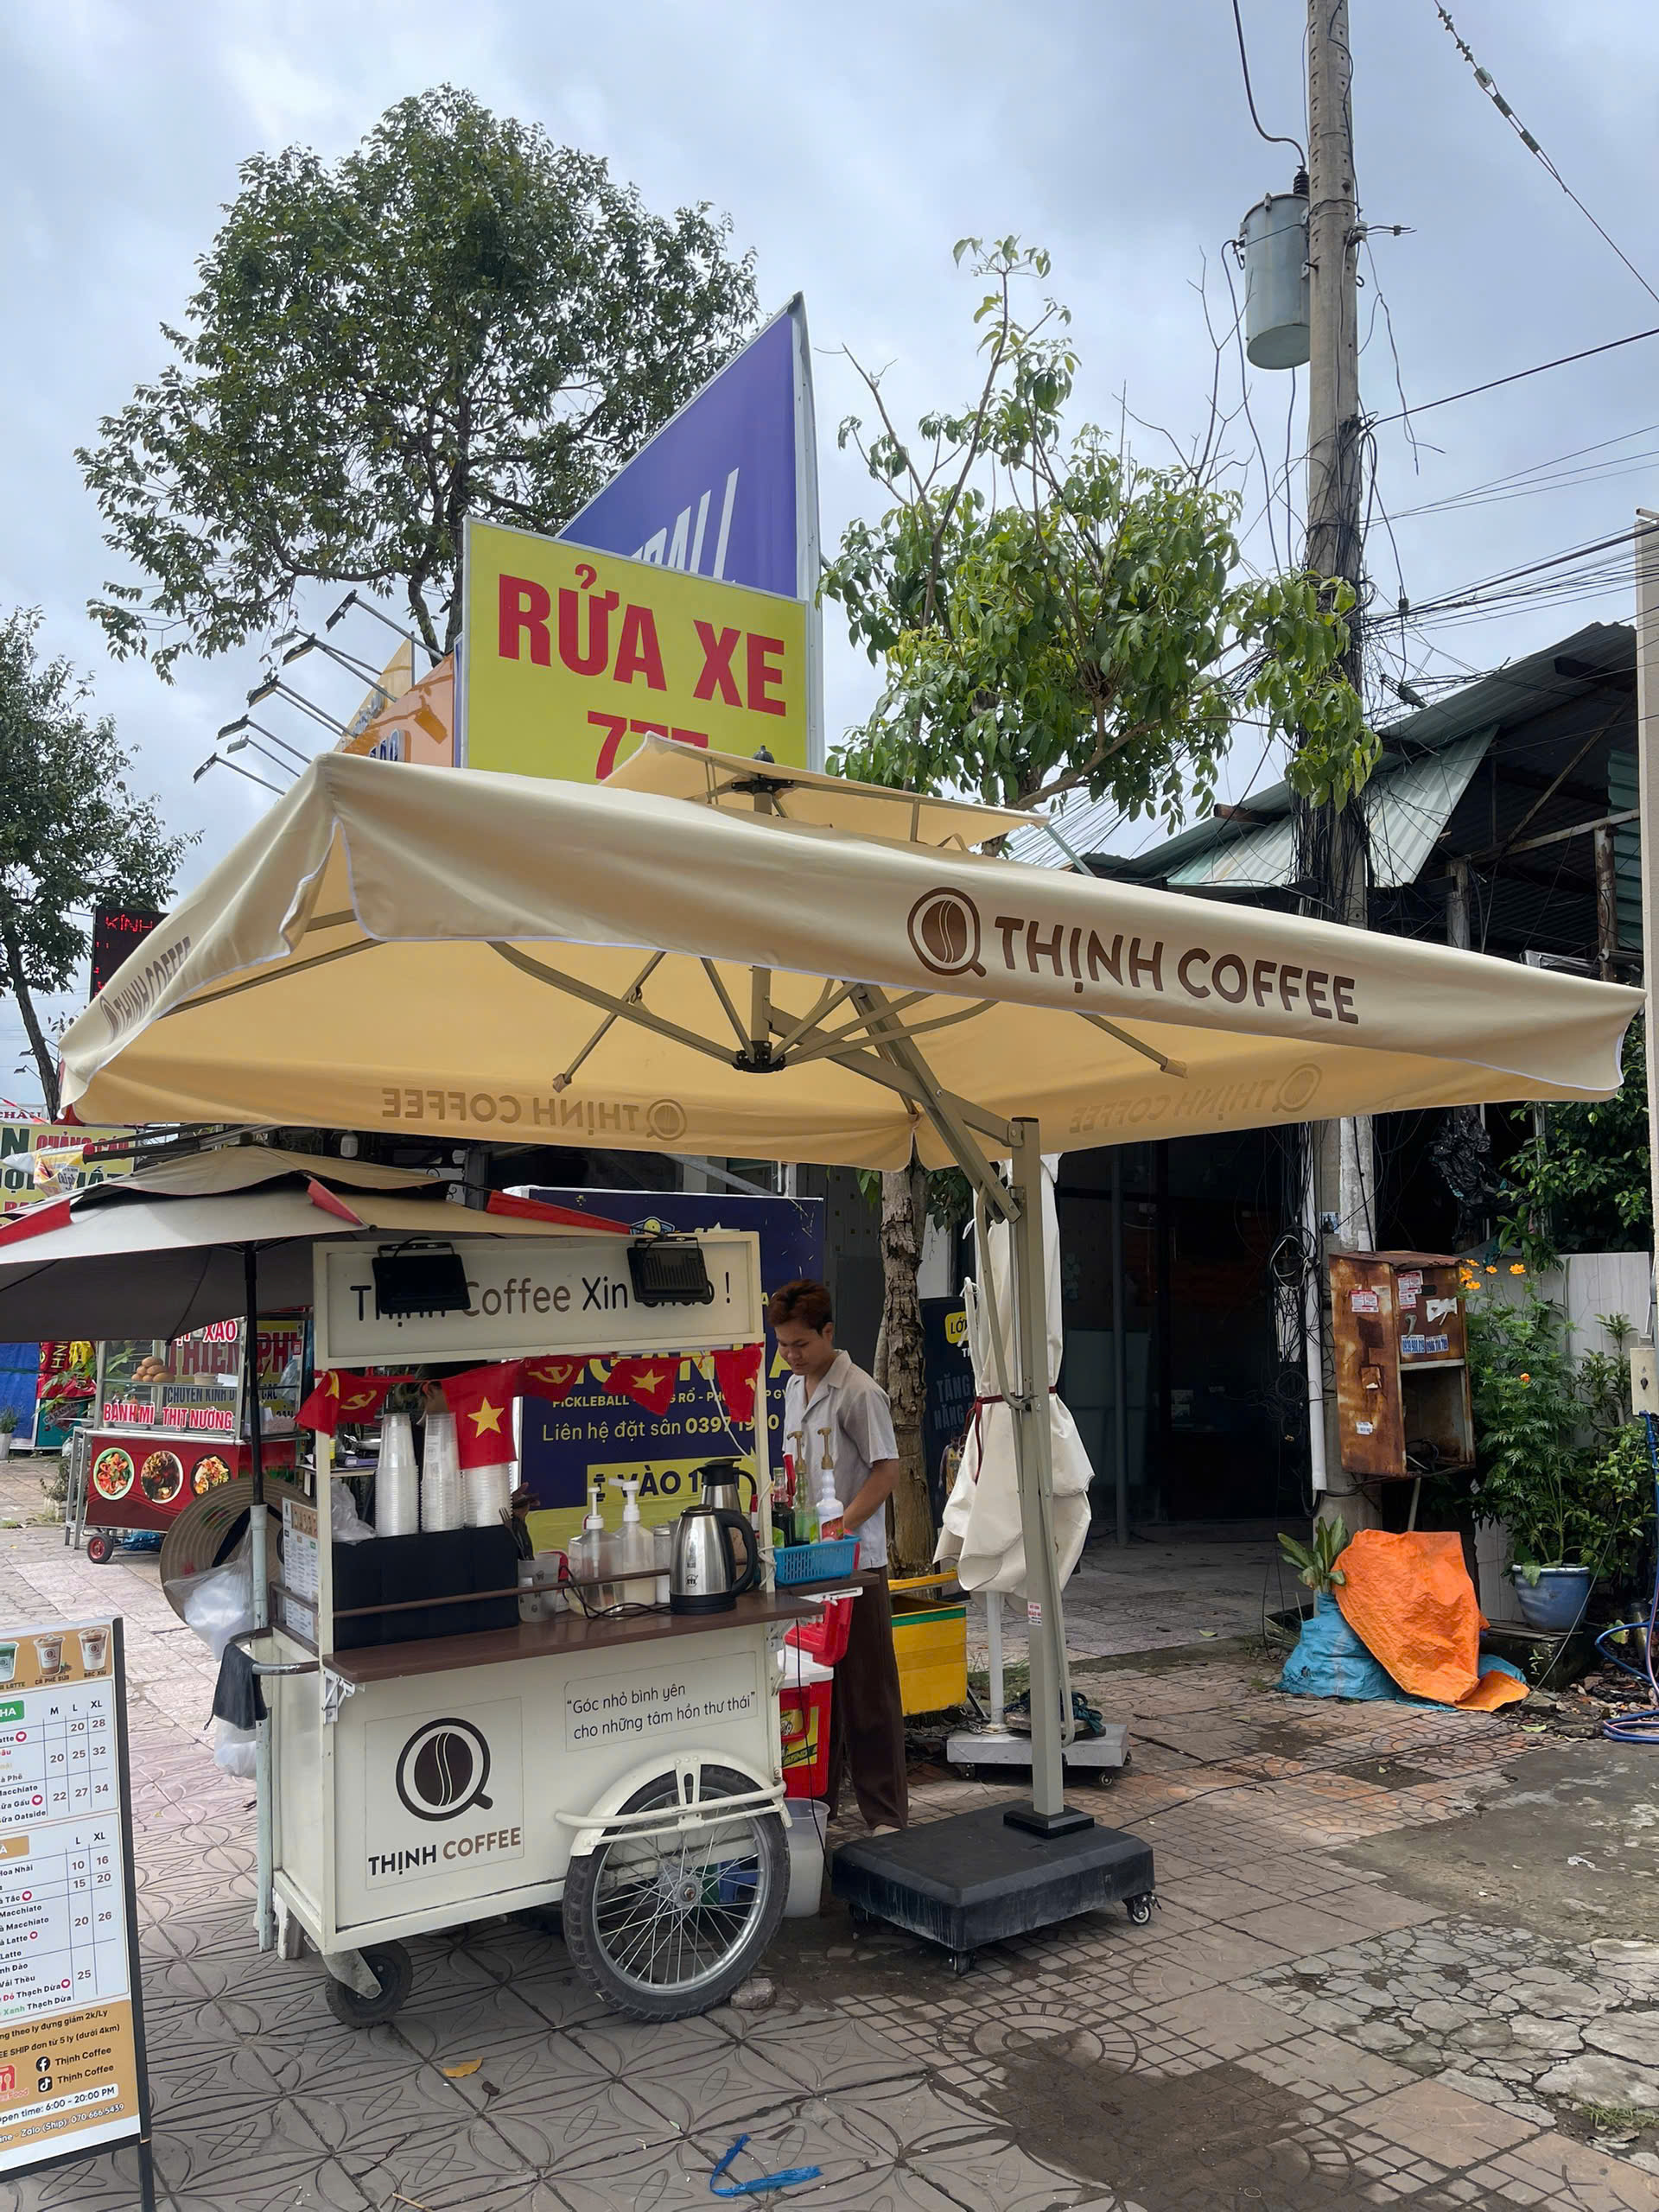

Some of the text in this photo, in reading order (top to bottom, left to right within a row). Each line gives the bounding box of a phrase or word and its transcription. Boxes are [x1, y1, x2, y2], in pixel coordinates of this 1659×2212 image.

[499, 564, 786, 717] RỬA XE
[995, 916, 1358, 1024] THỊNH COFFEE
[462, 1278, 571, 1317] Coffee
[582, 1275, 628, 1311] Xin
[162, 1406, 188, 1431] THỊT
[189, 1406, 234, 1431] NƯỚNG
[543, 1424, 582, 1441] Liên
[588, 1421, 609, 1443] hệ
[614, 1421, 645, 1444] đặt
[651, 1419, 681, 1435] sân
[603, 1692, 627, 1709] nhỏ
[632, 1688, 658, 1704] bình
[663, 1683, 685, 1701] yên
[91, 1700, 102, 1709] XL
[70, 1719, 105, 1732] 20 28
[574, 1725, 598, 1739] cho
[602, 1717, 643, 1734] những
[647, 1711, 673, 1726] tâm
[677, 1703, 700, 1720] hồn
[703, 1700, 725, 1715] thư
[50, 1746, 106, 1764] 20 25 32
[53, 1783, 109, 1802] 22 27 34
[15, 1810, 46, 1821] Oatside
[93, 1832, 105, 1841] XL
[368, 1827, 521, 1876] THỊNH COFFEE
[72, 1855, 109, 1871] 10 16
[73, 1873, 111, 1889] 15 20
[6, 1917, 49, 1930] Macchiato
[74, 1911, 112, 1927] 20 26
[7, 1936, 28, 1944] Latte
[0, 1950, 22, 1960] Latte
[77, 1970, 91, 1980] 25
[16, 1986, 42, 1999] Thạch
[27, 1998, 53, 2010] Thạch
[10, 2045, 30, 2056] SHIP
[67, 2035, 74, 2044] ly
[99, 2024, 120, 2035] 4km)
[11, 2027, 30, 2037] theo
[55, 2047, 111, 2066] Thịnh Coffee
[57, 2065, 114, 2084] Thịnh Coffee
[22, 2106, 44, 2117] time:
[46, 2099, 66, 2111] 6:00
[74, 2090, 99, 2104] 20:00
[101, 2087, 115, 2097] PM
[21, 2126, 41, 2138] Zalo
